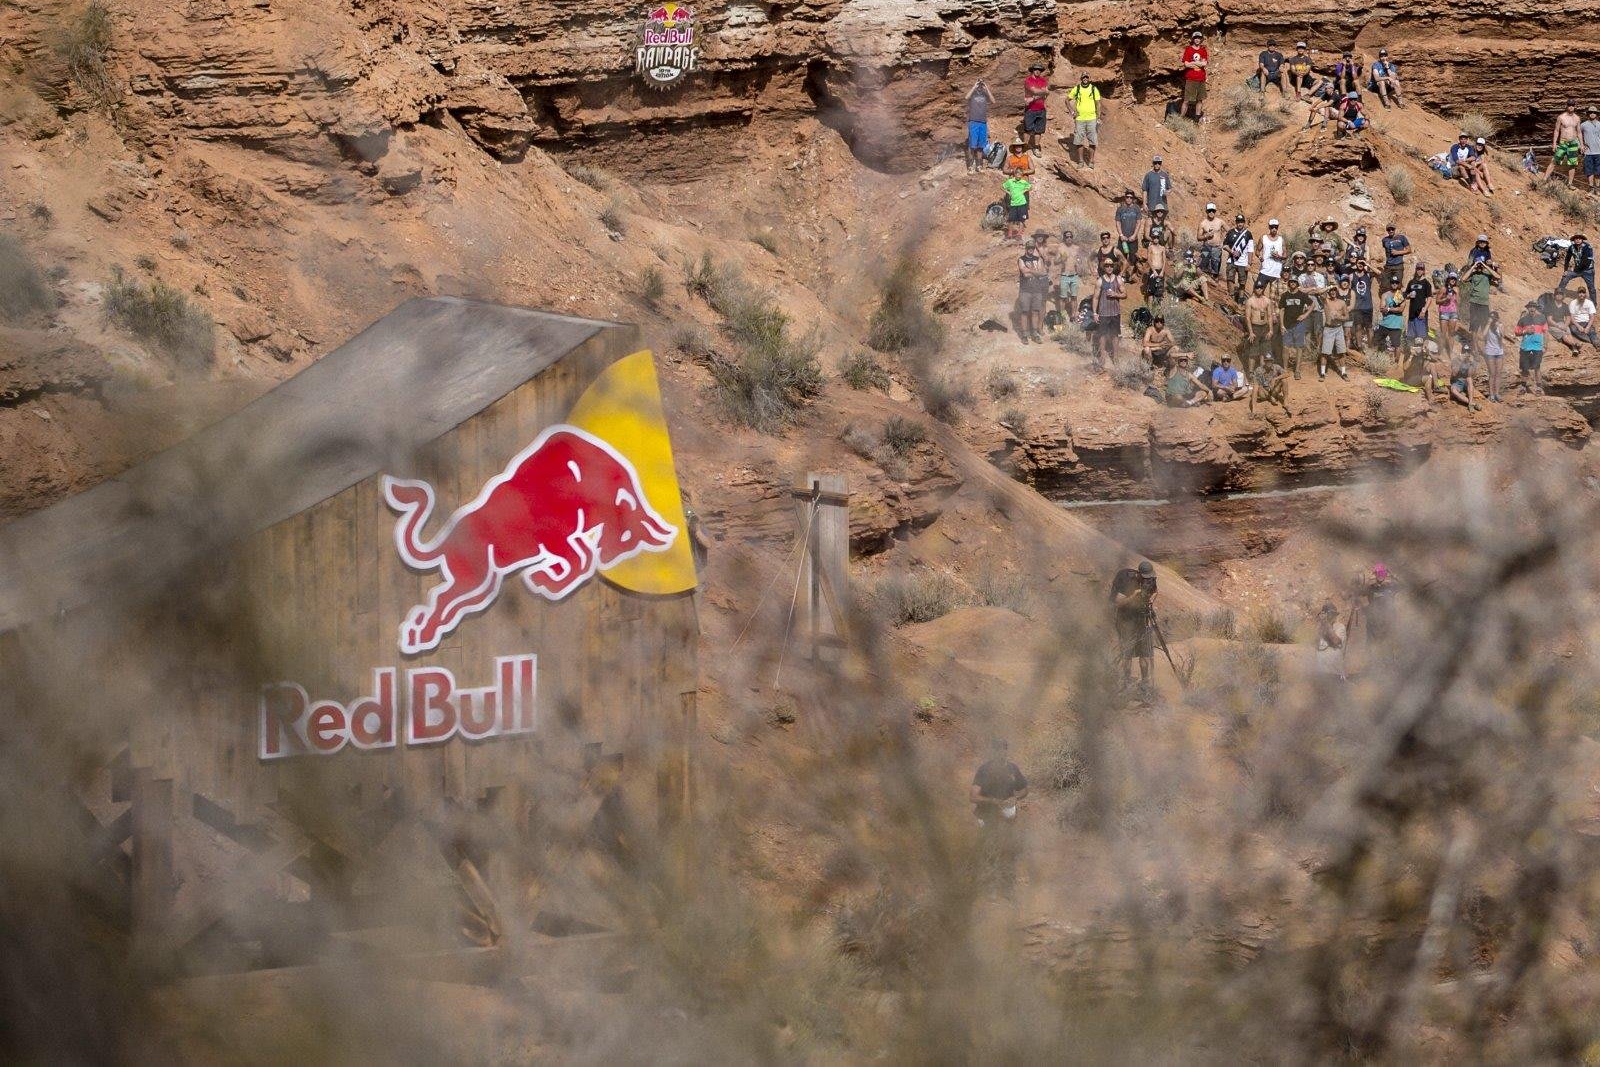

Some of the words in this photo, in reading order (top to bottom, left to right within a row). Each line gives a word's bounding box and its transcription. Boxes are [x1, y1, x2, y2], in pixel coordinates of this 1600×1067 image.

[645, 28, 668, 45] Red
[669, 28, 693, 44] Bull
[636, 46, 699, 72] RAMPAGE
[259, 666, 396, 759] Red
[407, 653, 537, 744] Bull
